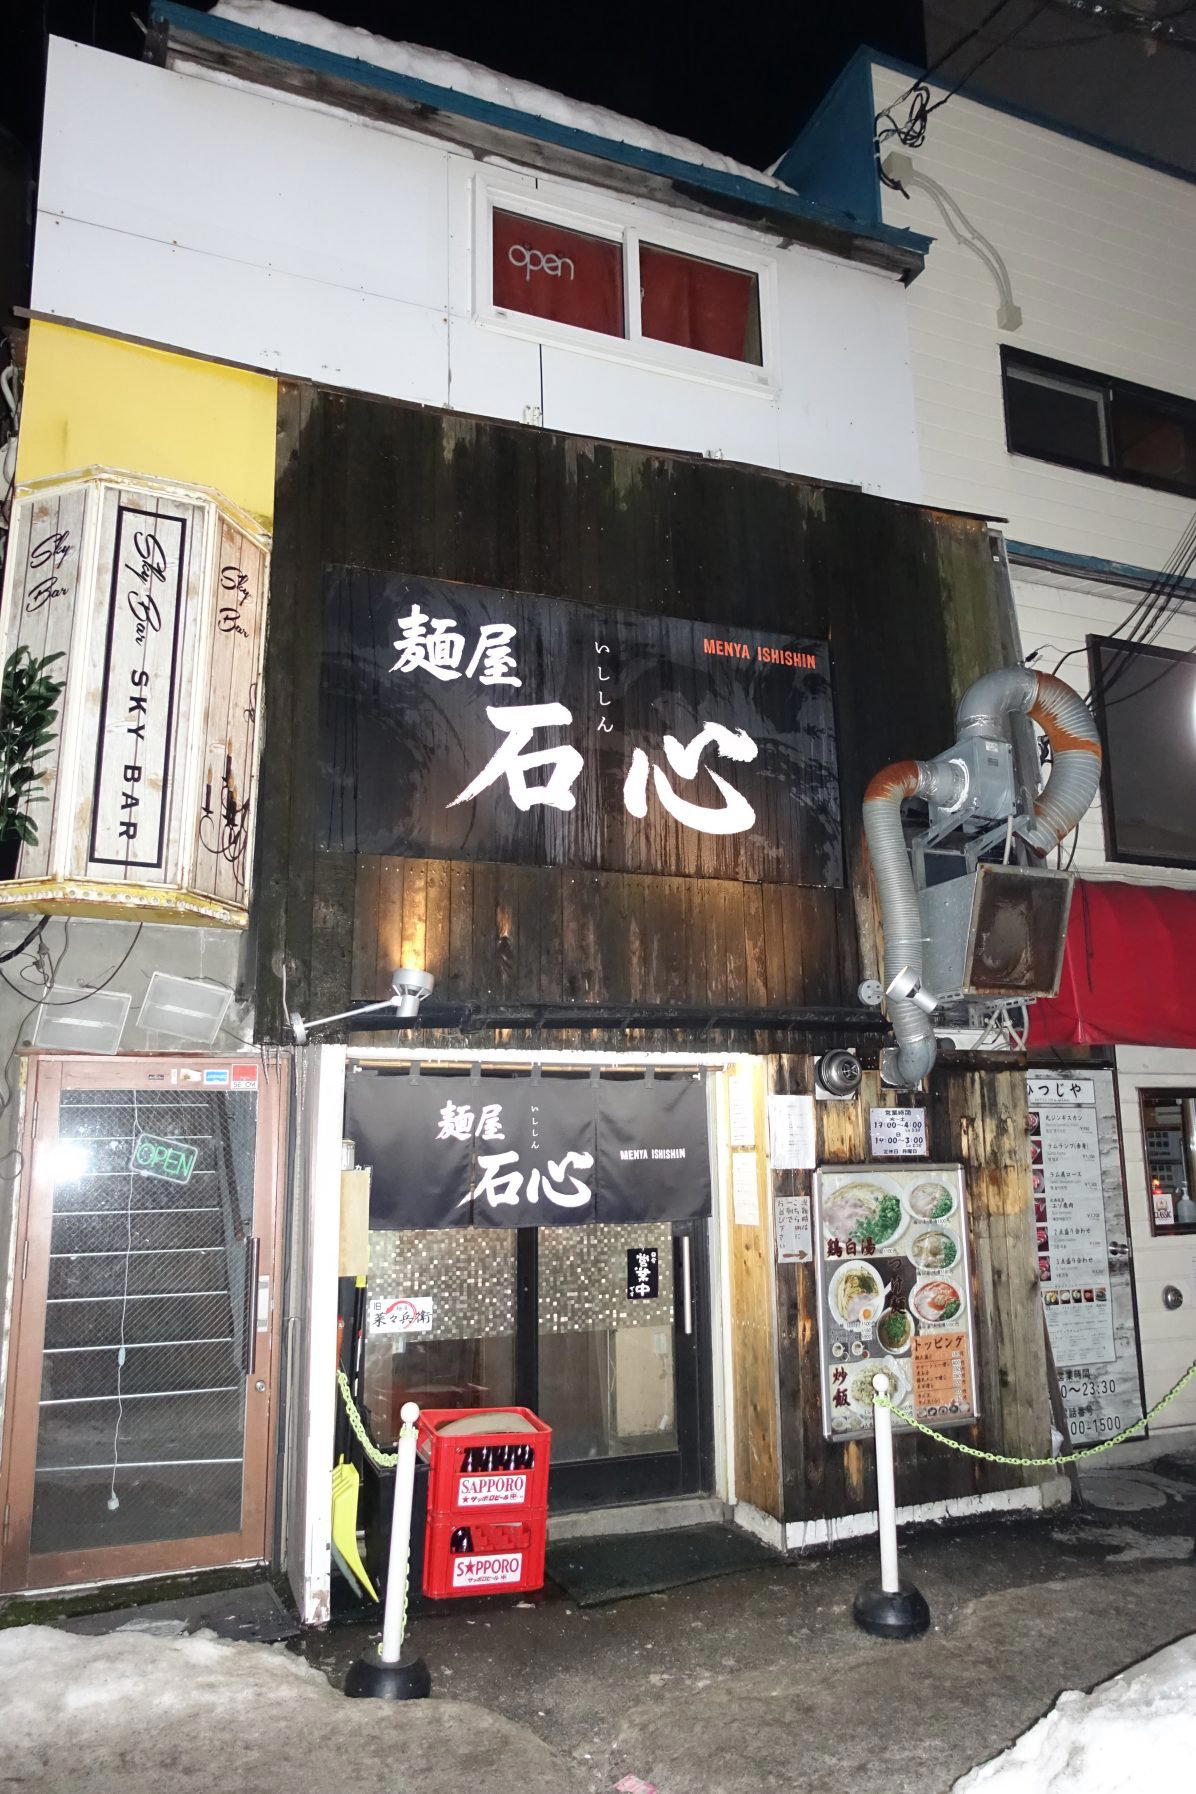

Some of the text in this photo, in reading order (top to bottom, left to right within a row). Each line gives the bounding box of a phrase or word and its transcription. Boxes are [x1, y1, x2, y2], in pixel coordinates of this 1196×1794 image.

[508, 244, 575, 281] open
[30, 530, 73, 570] Sky
[26, 576, 71, 613] Bar
[220, 565, 254, 605] Sky
[217, 607, 250, 639] Bar
[388, 604, 523, 688] 麺屋
[703, 638, 816, 670] MENYA ISHISHIN
[117, 530, 168, 841] Sky Bar SKY BAR
[594, 641, 614, 734] いししん
[445, 702, 760, 836] 石心
[435, 1099, 507, 1141] 麺屋
[530, 1105, 540, 1149] いししん
[136, 1143, 195, 1177] OPEN
[620, 1148, 686, 1160] MENYA ISHISHIN
[456, 1150, 594, 1208] 石心
[826, 1236, 877, 1257] 鶏白湯
[634, 1252, 651, 1297] 営業中
[373, 1302, 382, 1310] 旧
[915, 1335, 964, 1352] トッピング
[461, 1476, 524, 1494] SAPPORO
[470, 1494, 509, 1503] サッポロビール
